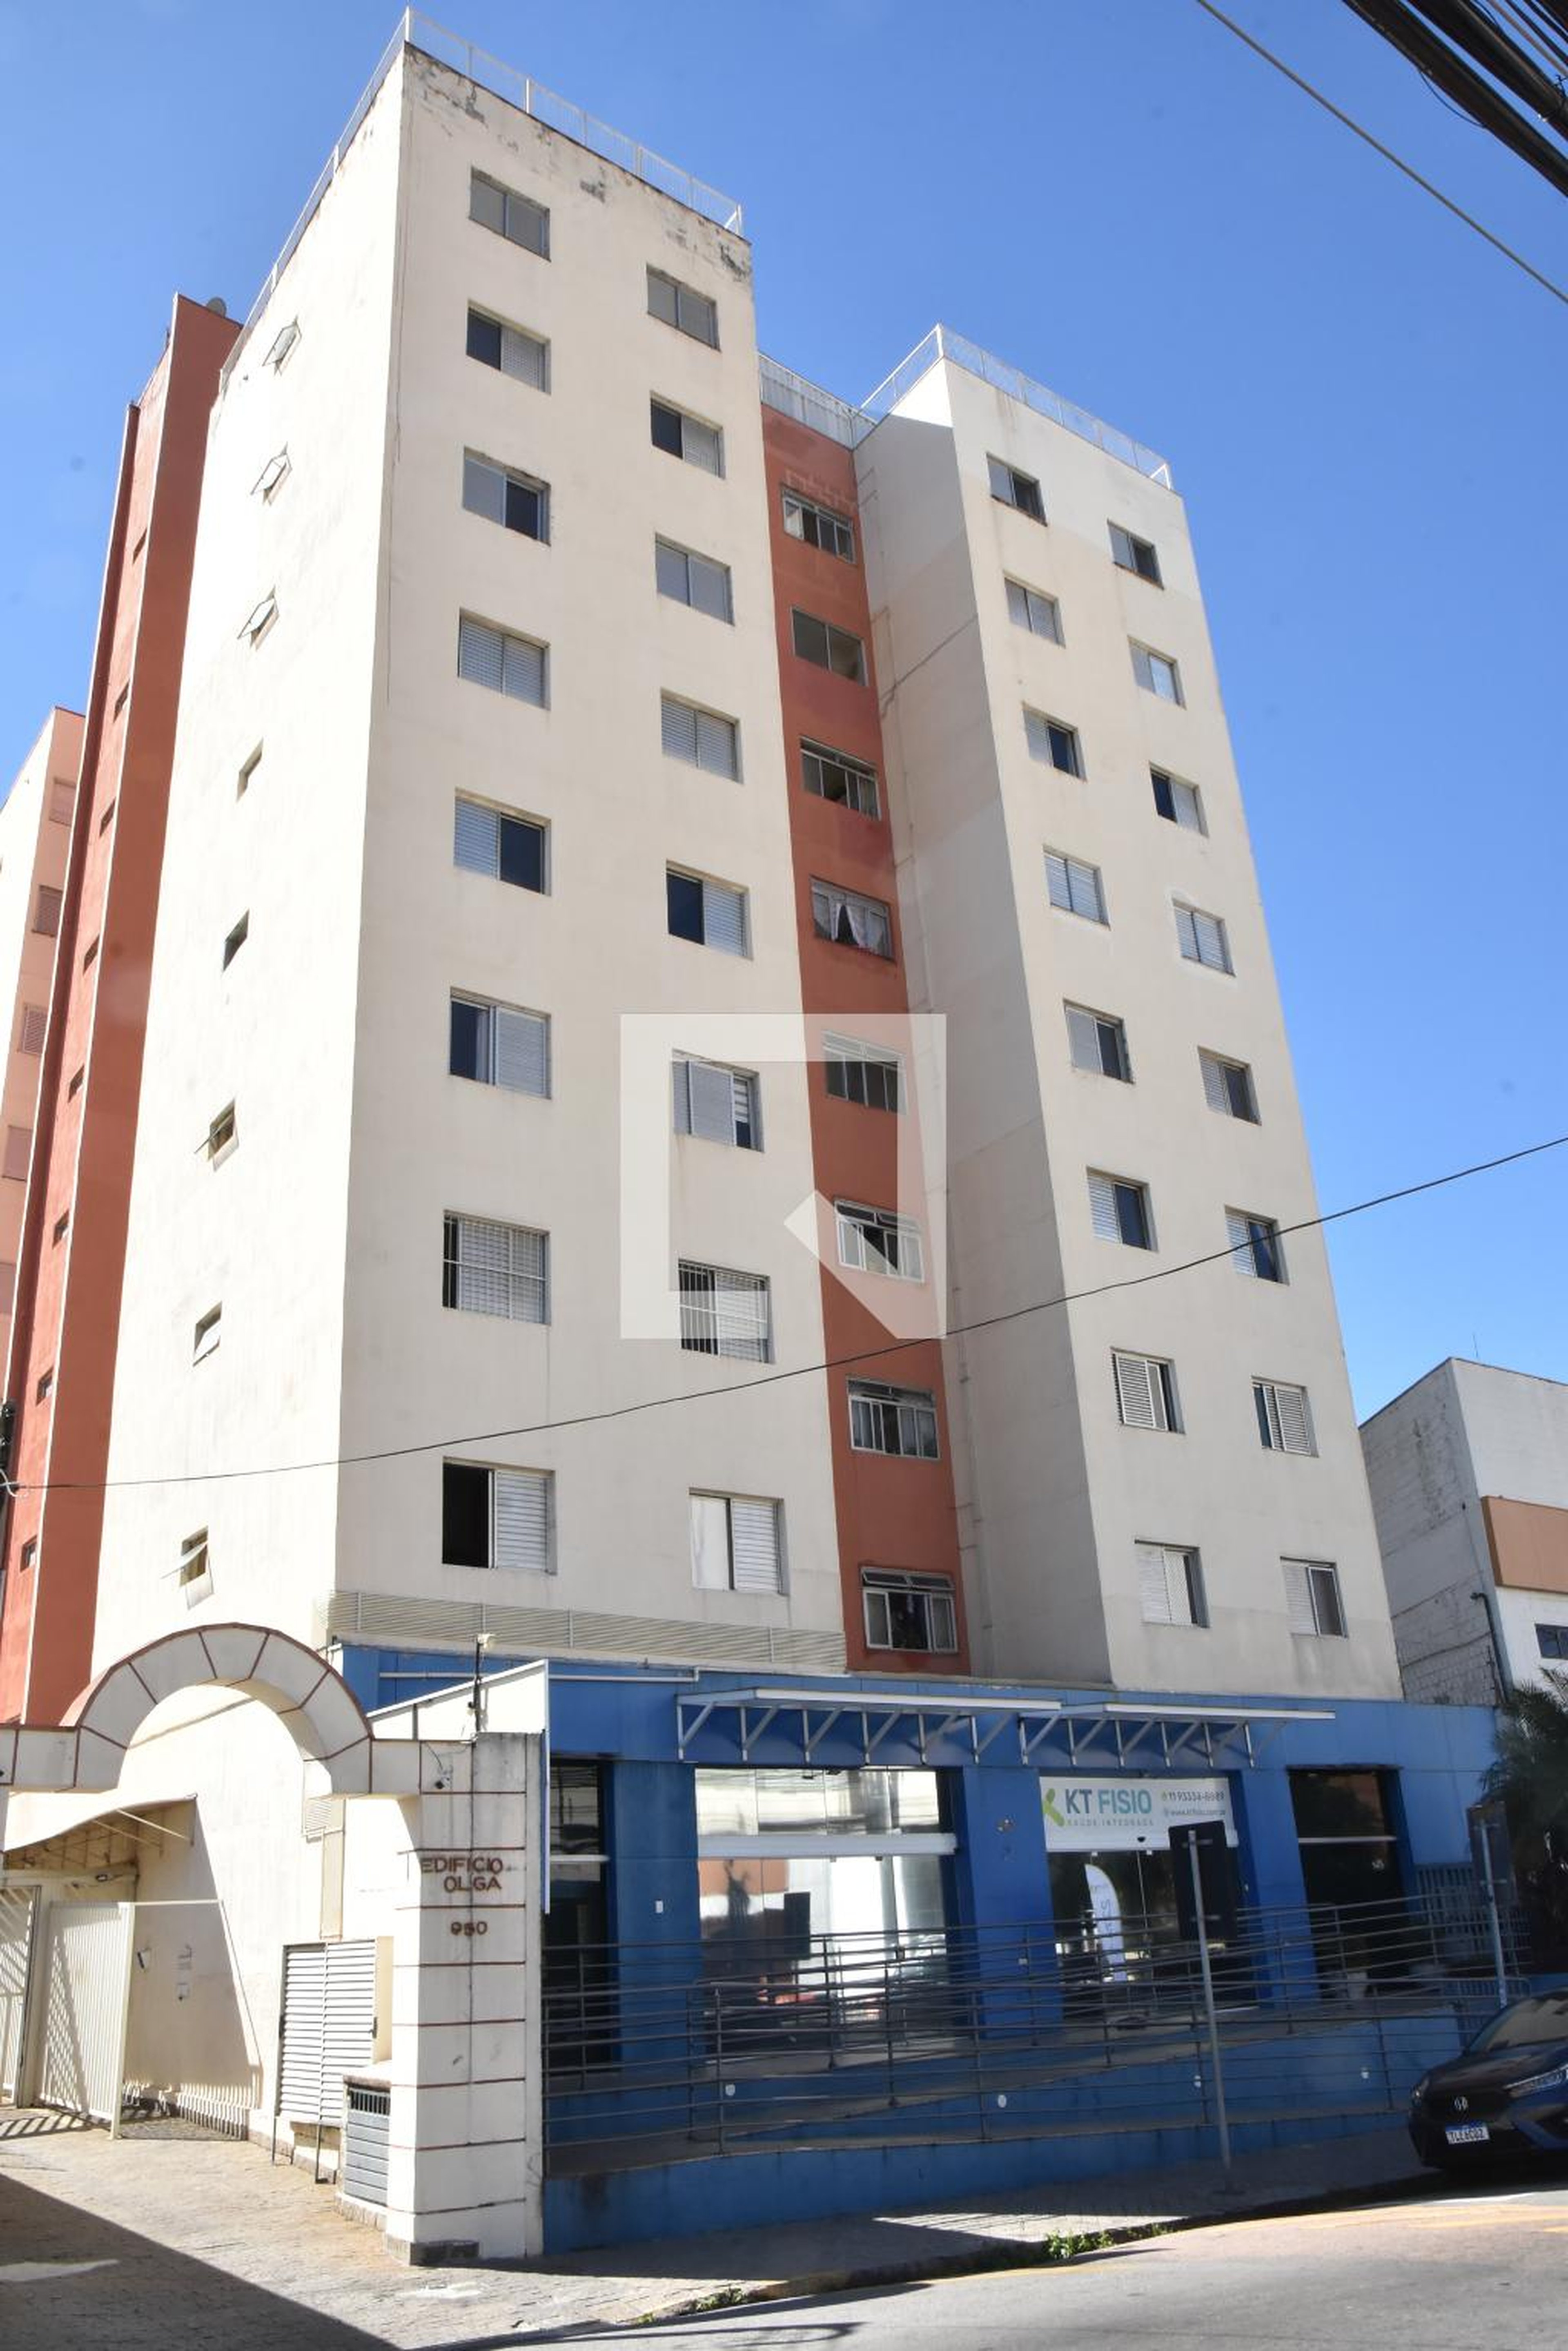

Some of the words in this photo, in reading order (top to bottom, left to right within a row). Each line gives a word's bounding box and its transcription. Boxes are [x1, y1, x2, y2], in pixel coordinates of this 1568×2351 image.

[1065, 1789, 1092, 1814] KT
[1098, 1789, 1152, 1814] FISIO
[444, 1876, 502, 1893] OLGA
